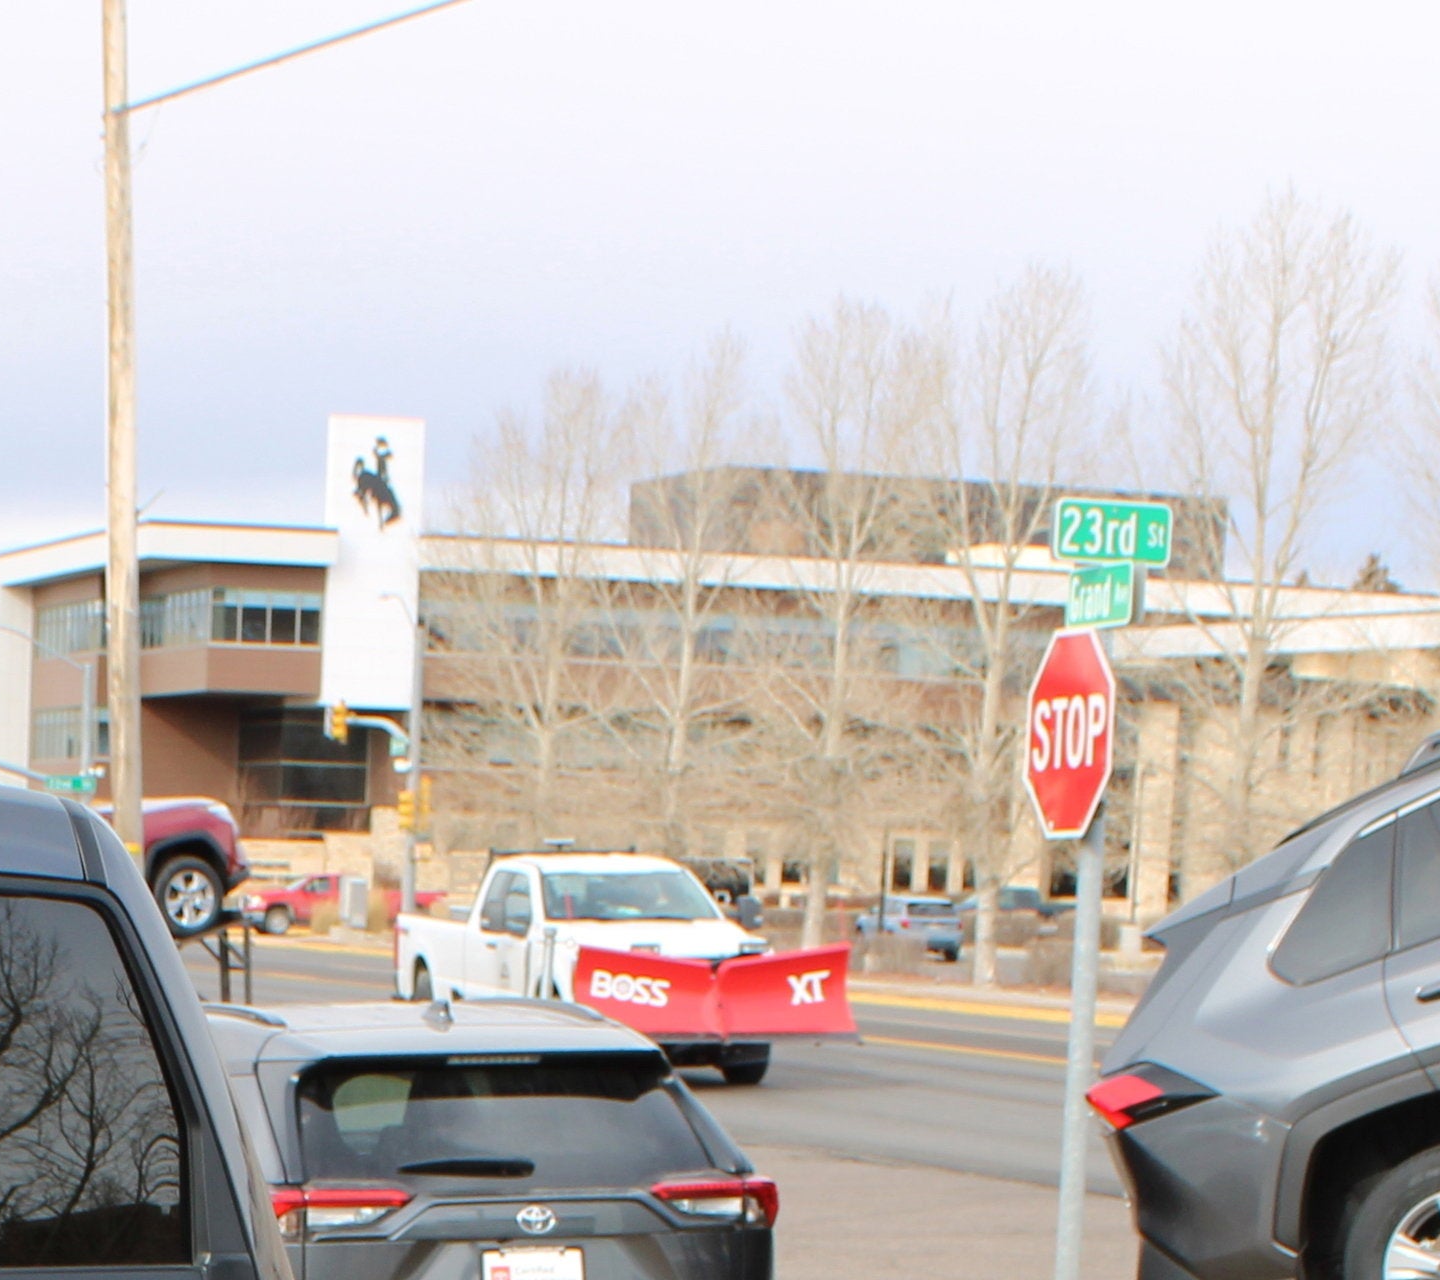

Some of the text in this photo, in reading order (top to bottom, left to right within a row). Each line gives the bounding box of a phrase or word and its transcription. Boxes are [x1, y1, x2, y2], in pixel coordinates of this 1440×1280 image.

[1061, 506, 1165, 557] 23rd St
[1070, 575, 1112, 622] Grand
[1032, 693, 1106, 772] STOP
[589, 969, 671, 1008] BOSS
[787, 969, 831, 1006] XT
